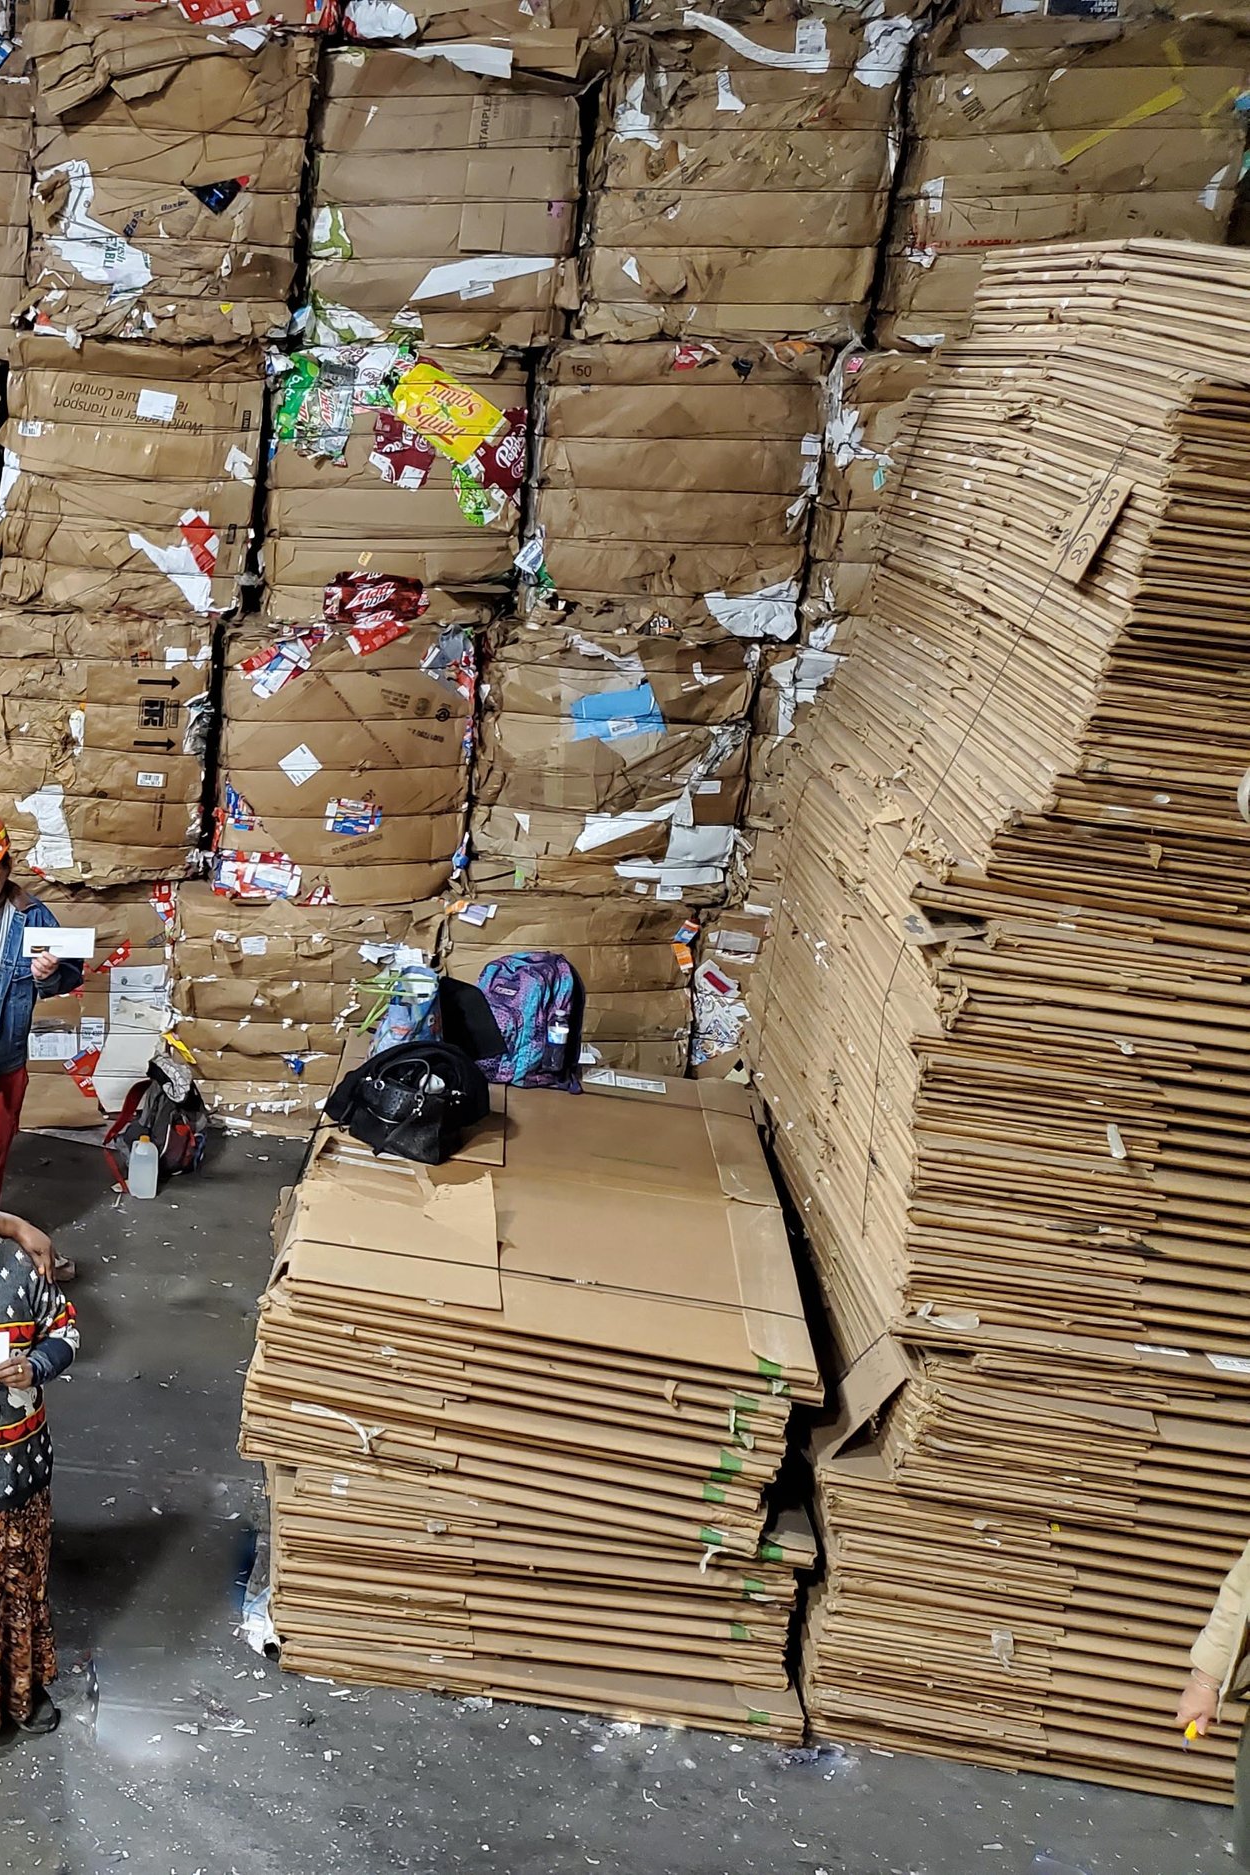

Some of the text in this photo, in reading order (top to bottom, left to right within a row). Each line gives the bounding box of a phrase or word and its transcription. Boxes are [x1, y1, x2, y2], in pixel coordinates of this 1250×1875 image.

[572, 364, 592, 377] 150
[70, 381, 114, 402] Control
[426, 385, 483, 416] Squirt
[54, 396, 108, 419] Transport
[111, 407, 122, 420] in
[172, 418, 203, 436] World
[408, 403, 469, 440] Squirt
